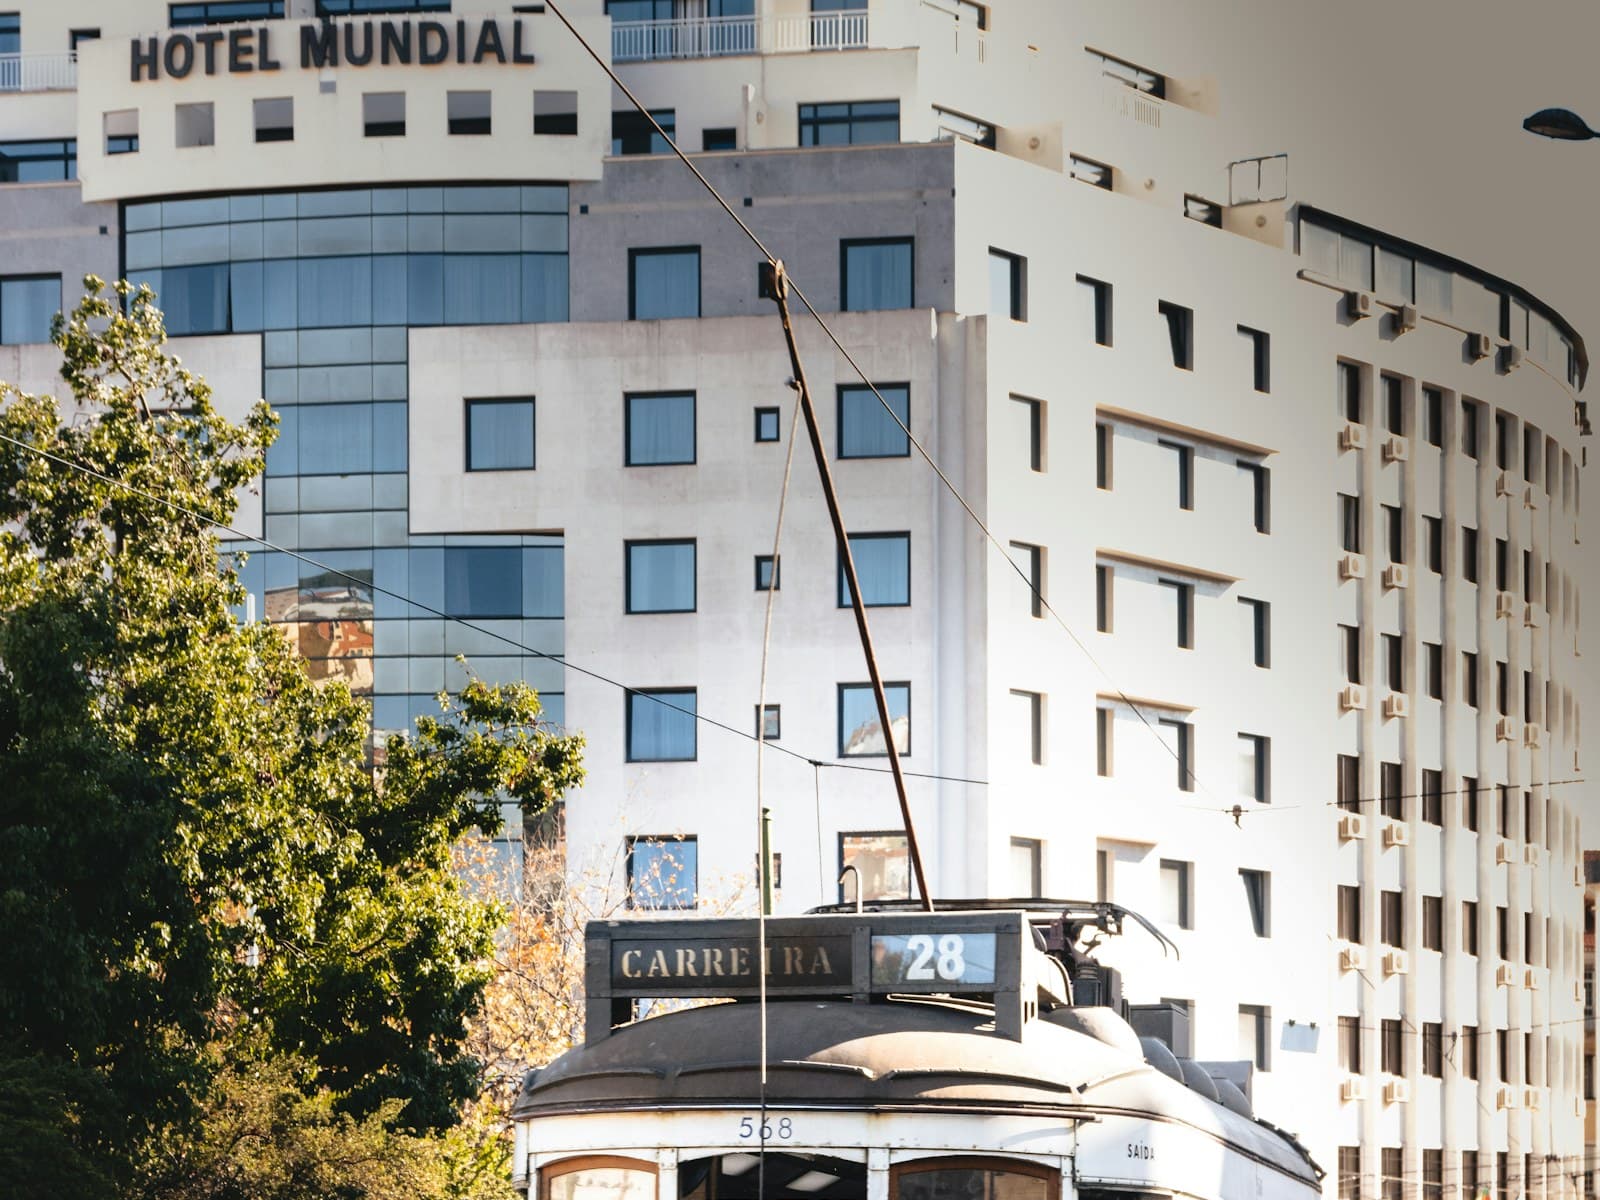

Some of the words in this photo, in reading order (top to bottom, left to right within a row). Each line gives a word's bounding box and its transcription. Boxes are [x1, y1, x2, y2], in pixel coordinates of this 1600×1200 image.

[130, 28, 280, 82] HOTEL
[300, 19, 535, 68] MUNDIAL
[905, 933, 966, 981] 28
[739, 1117, 792, 1140] 568
